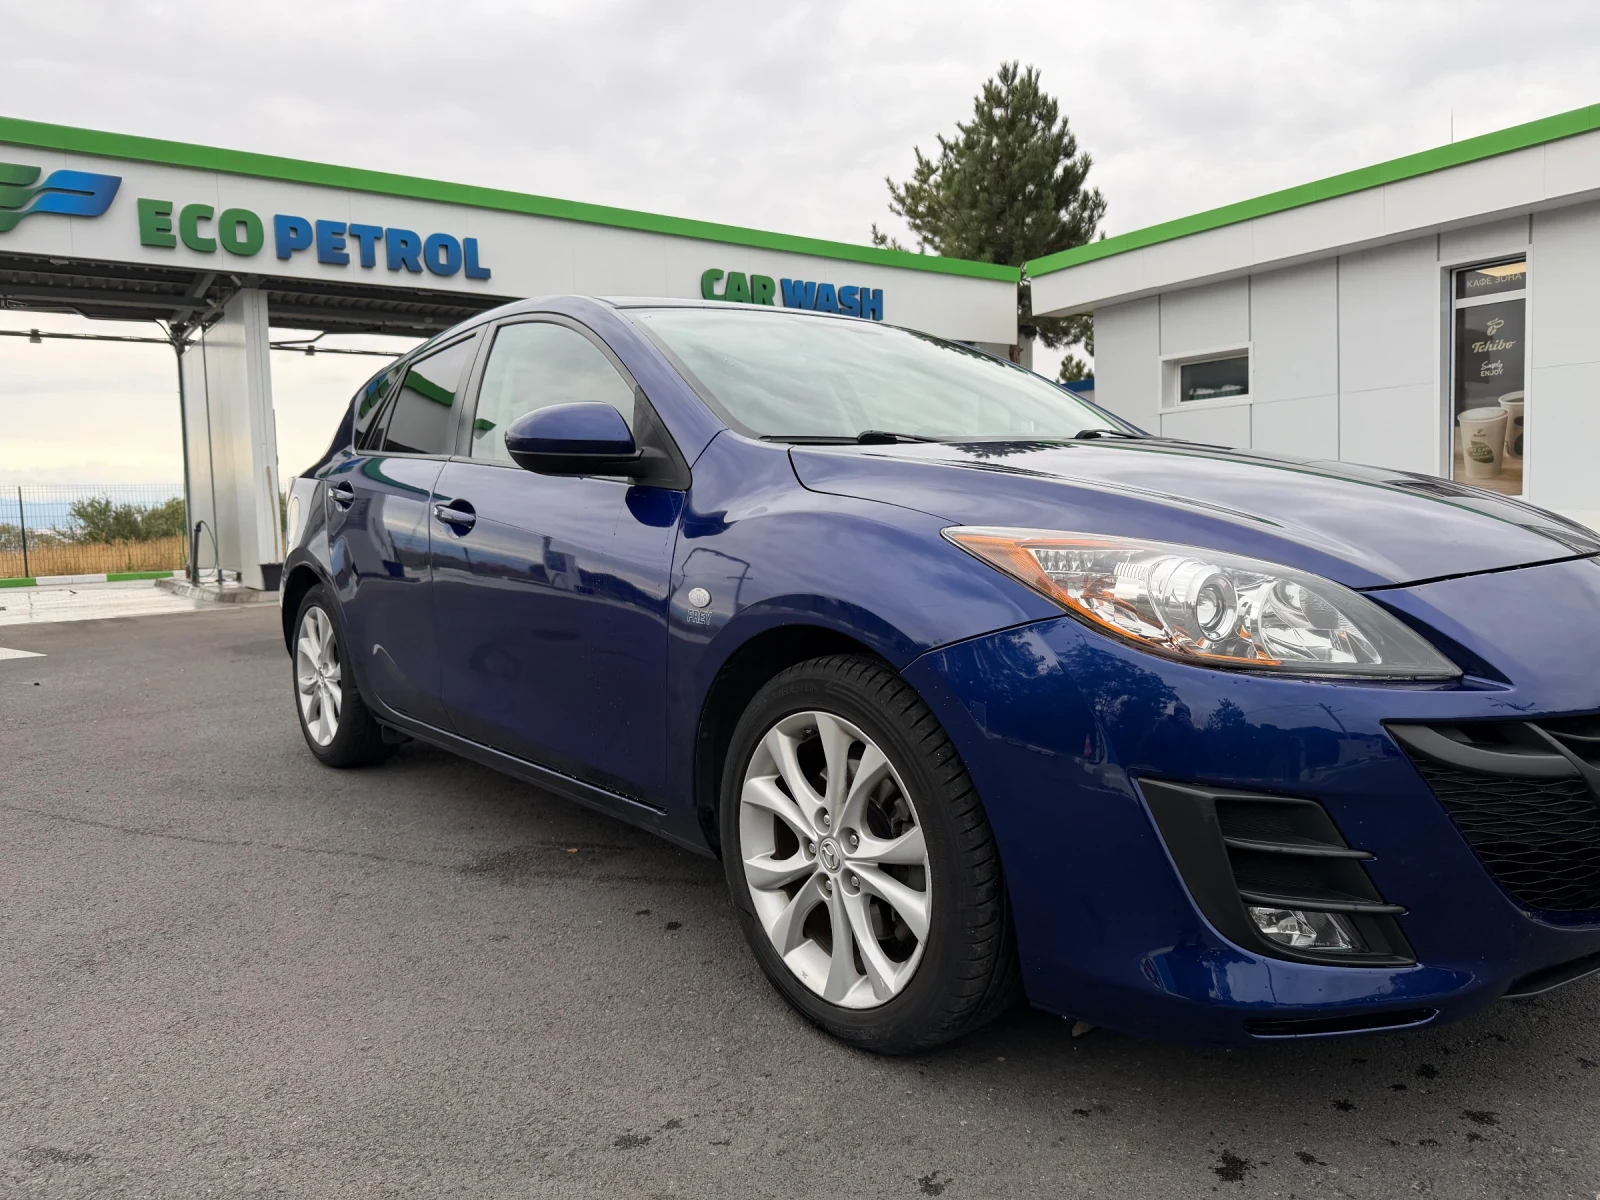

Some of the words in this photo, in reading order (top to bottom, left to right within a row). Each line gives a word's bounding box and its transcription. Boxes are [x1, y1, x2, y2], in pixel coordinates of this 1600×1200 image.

[137, 197, 264, 257] ECO
[273, 214, 492, 280] PETROL
[1466, 276, 1492, 288] КАФЕ
[1495, 272, 1522, 284] ЗОНА
[701, 268, 776, 306] CAR
[780, 278, 884, 321] WASH
[1471, 339, 1516, 353] Tchibo
[1480, 368, 1503, 377] ENJOY
[687, 609, 713, 625] FREY
